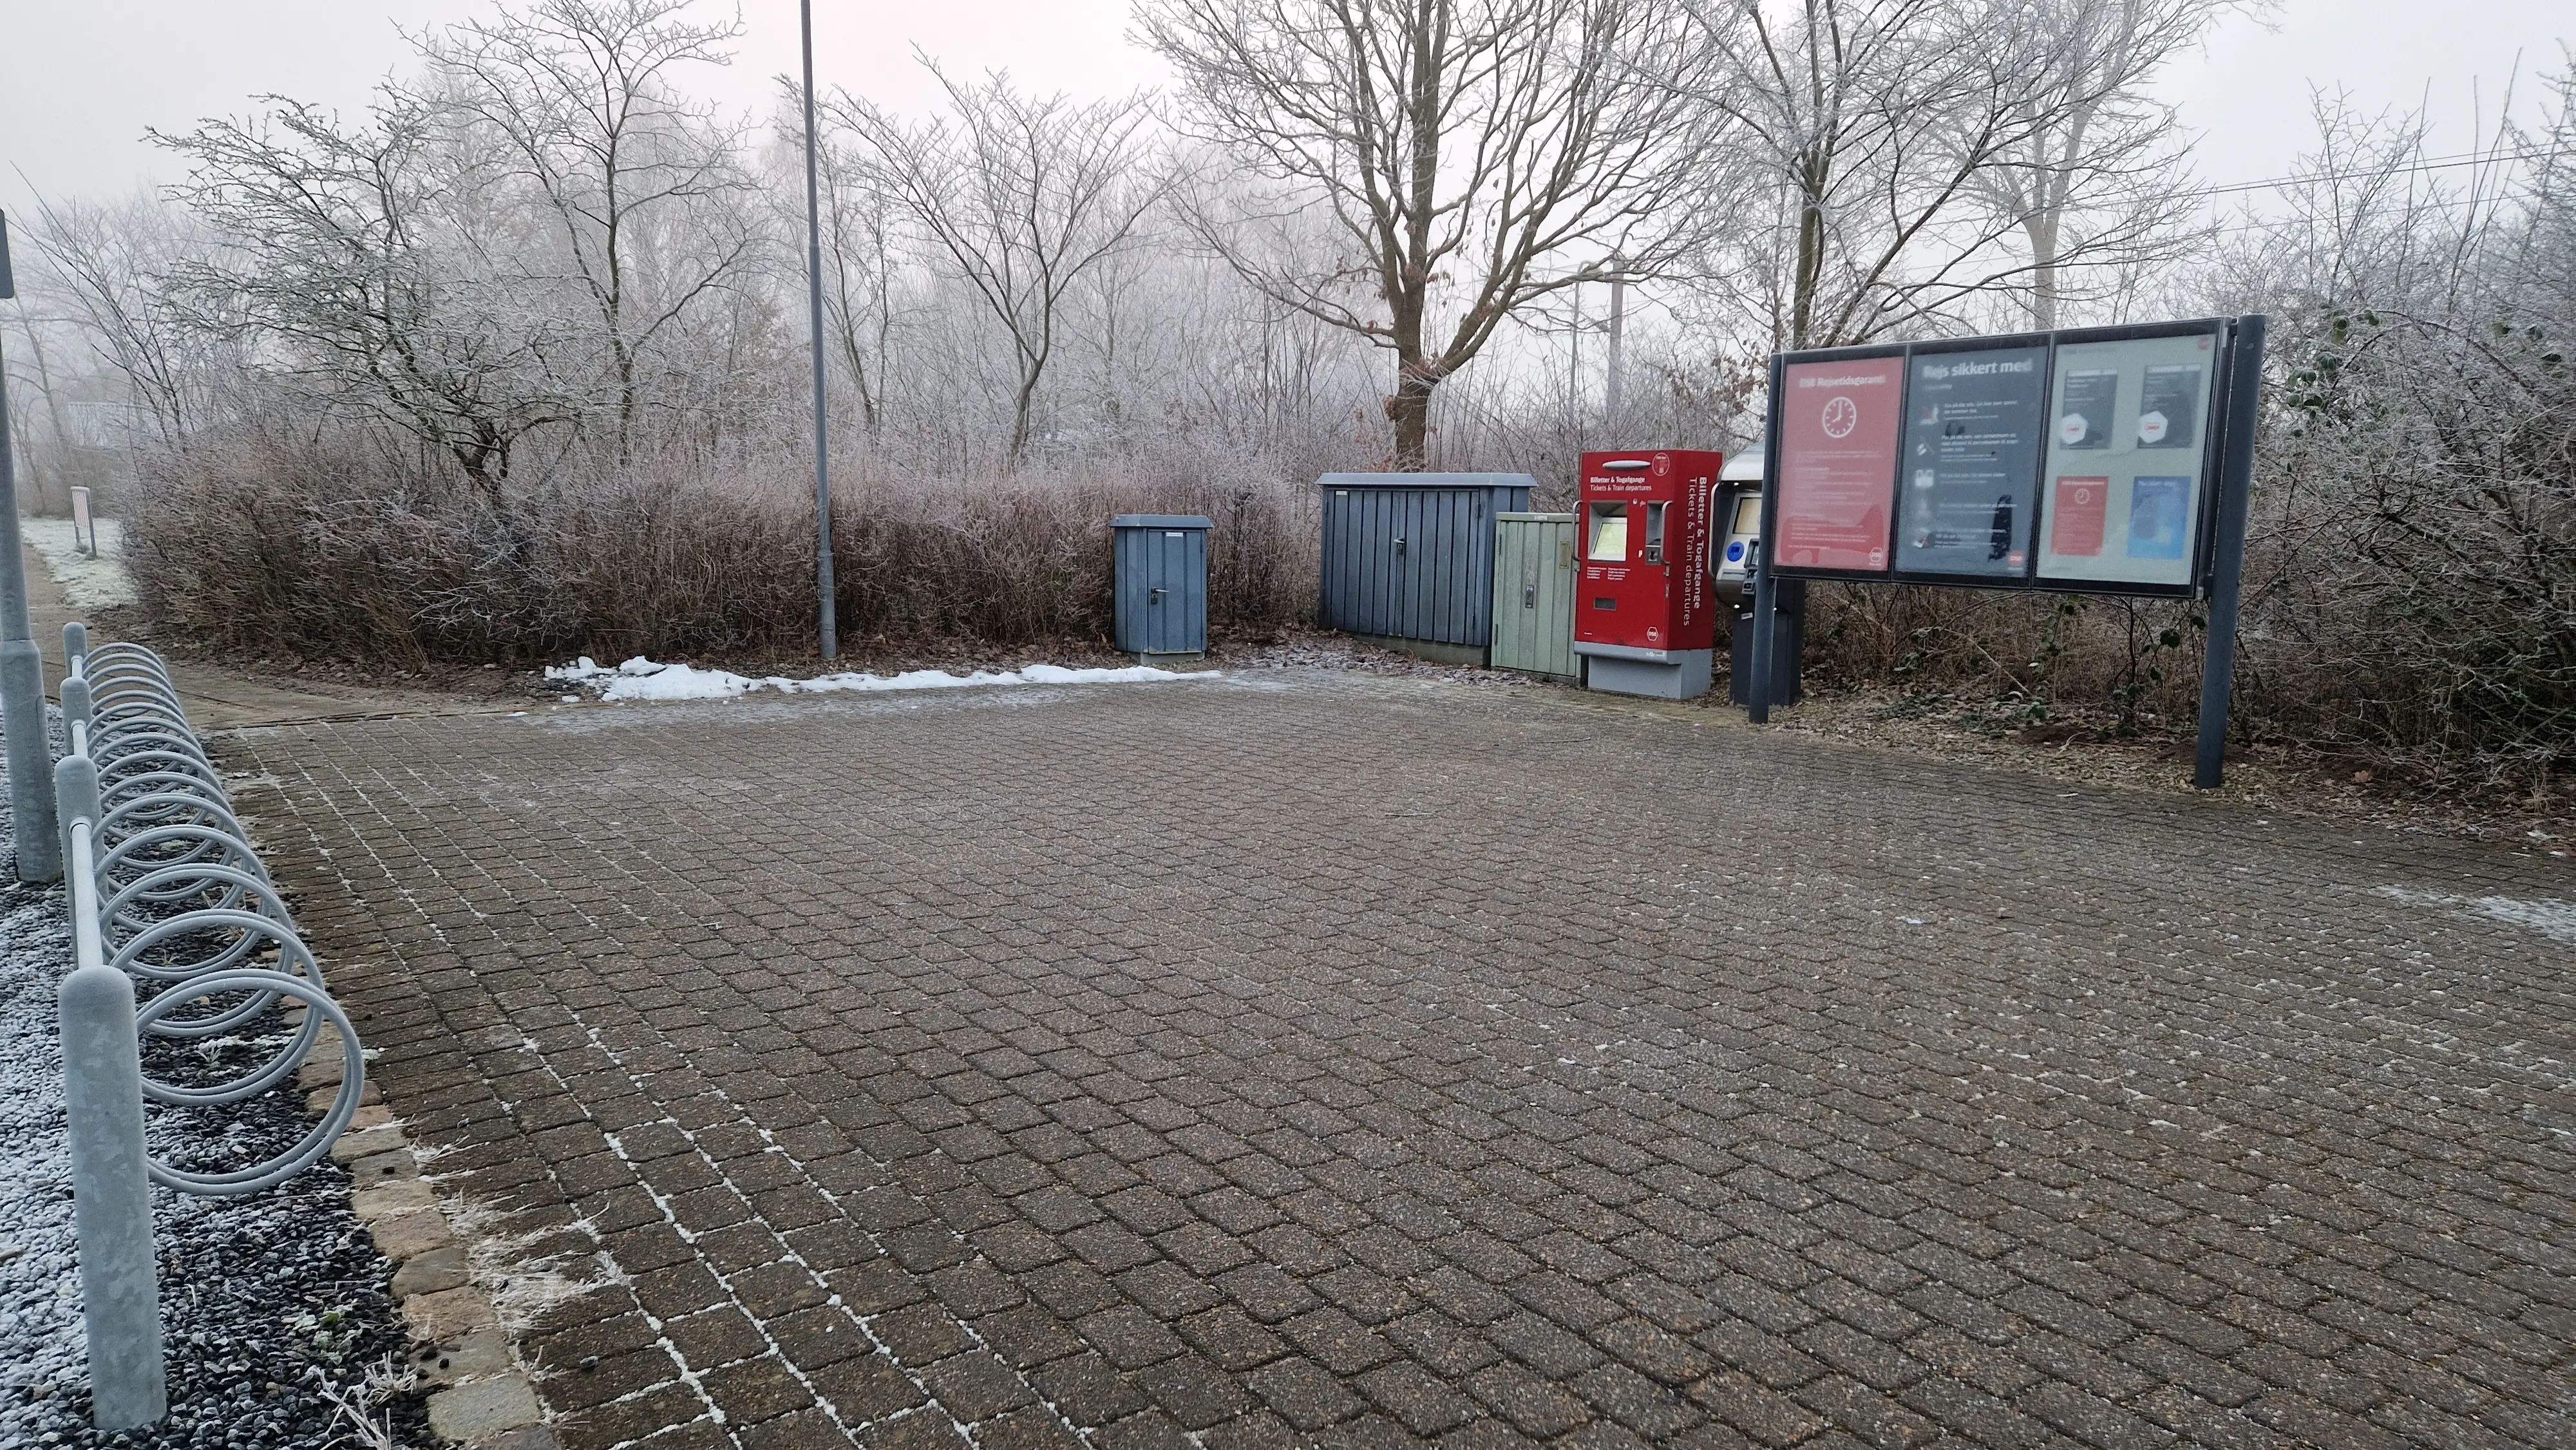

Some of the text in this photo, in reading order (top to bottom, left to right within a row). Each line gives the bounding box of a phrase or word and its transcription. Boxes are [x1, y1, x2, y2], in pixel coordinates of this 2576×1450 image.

[1951, 361, 1998, 377] sikkert
[1683, 478, 1697, 626] Tickets & Train departures
[1694, 477, 1707, 609] Billetter & Togafgange
